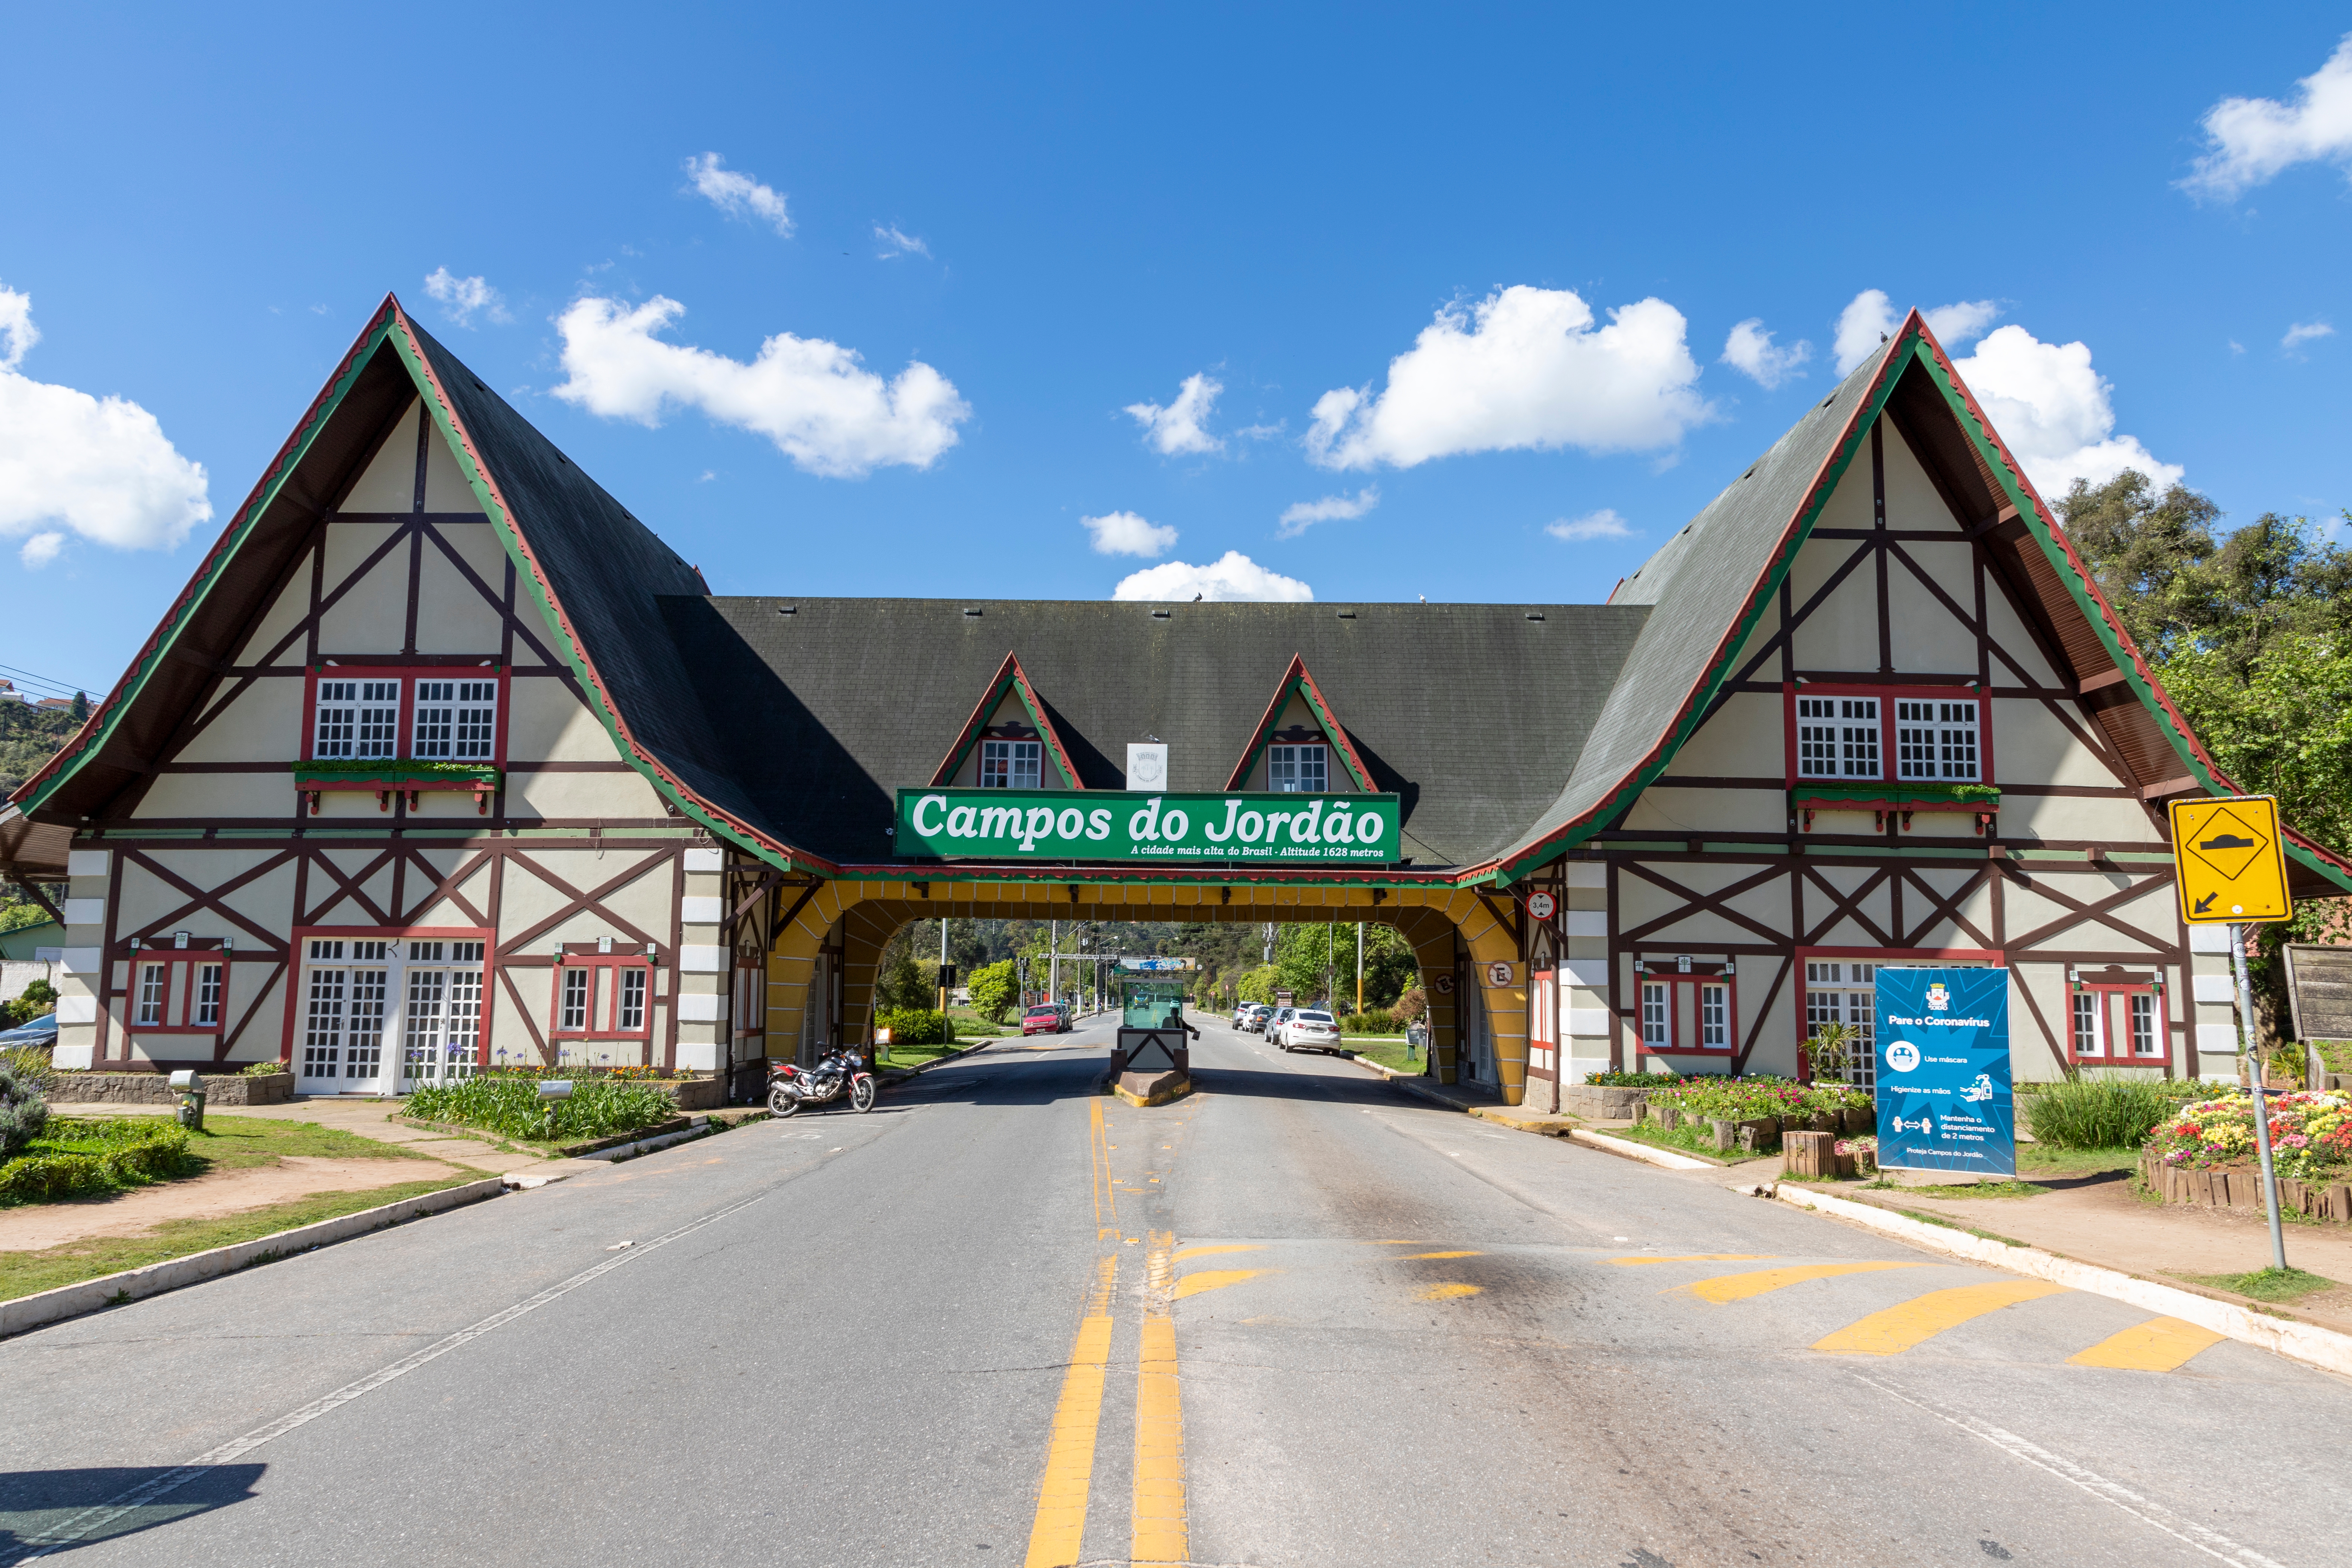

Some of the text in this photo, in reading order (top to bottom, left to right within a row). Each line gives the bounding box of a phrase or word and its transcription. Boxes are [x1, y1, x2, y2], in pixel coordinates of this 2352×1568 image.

[913, 794, 1384, 851] Campos do Jordão
[1130, 845, 1138, 854] A
[1141, 845, 1174, 854] cidade
[1177, 845, 1201, 855] mais
[1204, 846, 1224, 855] alta
[1228, 846, 1239, 855] do
[1242, 847, 1272, 856] Brasil
[1280, 847, 1320, 856] Altitude
[1323, 847, 1348, 856] 1628
[1350, 848, 1384, 857] metros
[1497, 968, 1505, 982] E
[1889, 1015, 1913, 1025] Pare
[1924, 1016, 1990, 1027] Coronavírus
[1941, 1124, 1995, 1133] distanciamento
